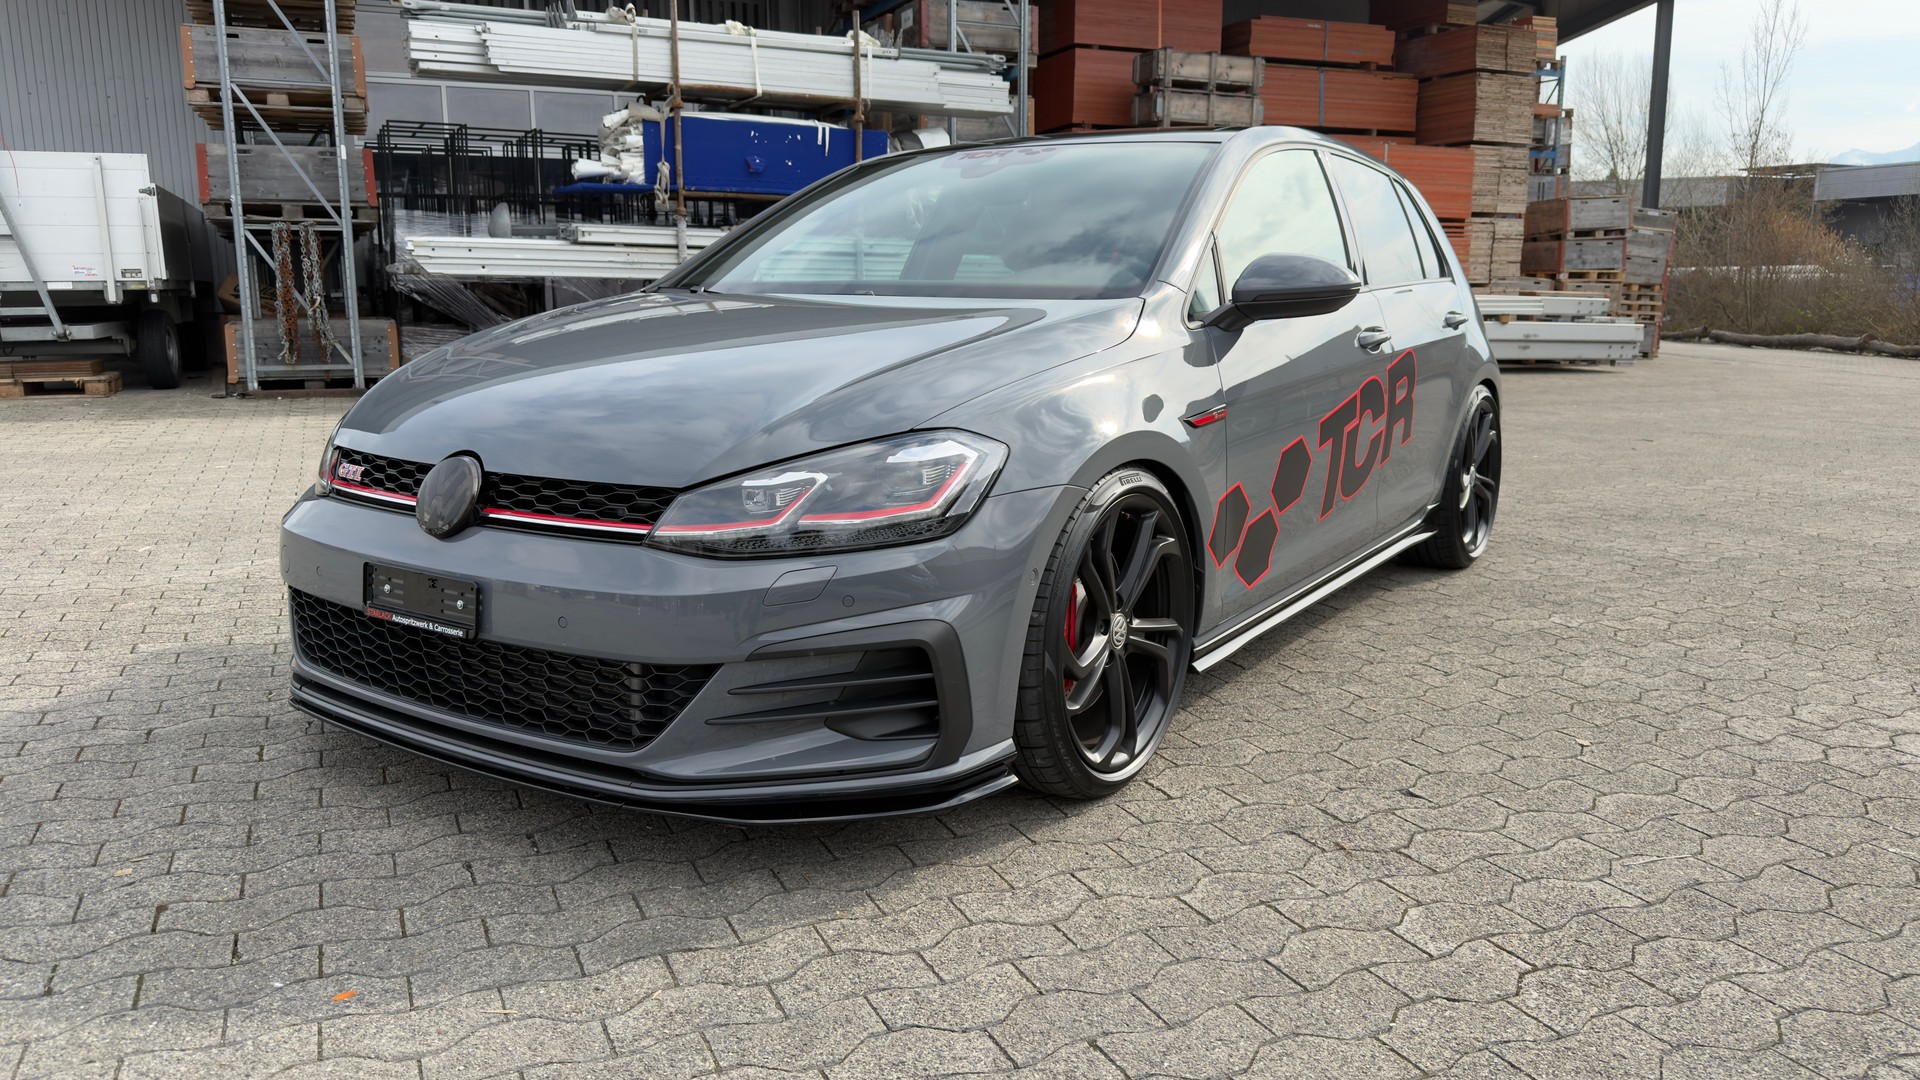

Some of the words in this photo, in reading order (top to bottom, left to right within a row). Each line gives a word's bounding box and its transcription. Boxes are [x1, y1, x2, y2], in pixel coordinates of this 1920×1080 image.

[1317, 348, 1417, 523] TCR
[338, 462, 365, 482] GTI
[1118, 473, 1143, 486] PIRELLI
[391, 614, 428, 629] Autospritzwerk
[428, 622, 434, 630] &
[434, 623, 464, 637] Carrosserie
